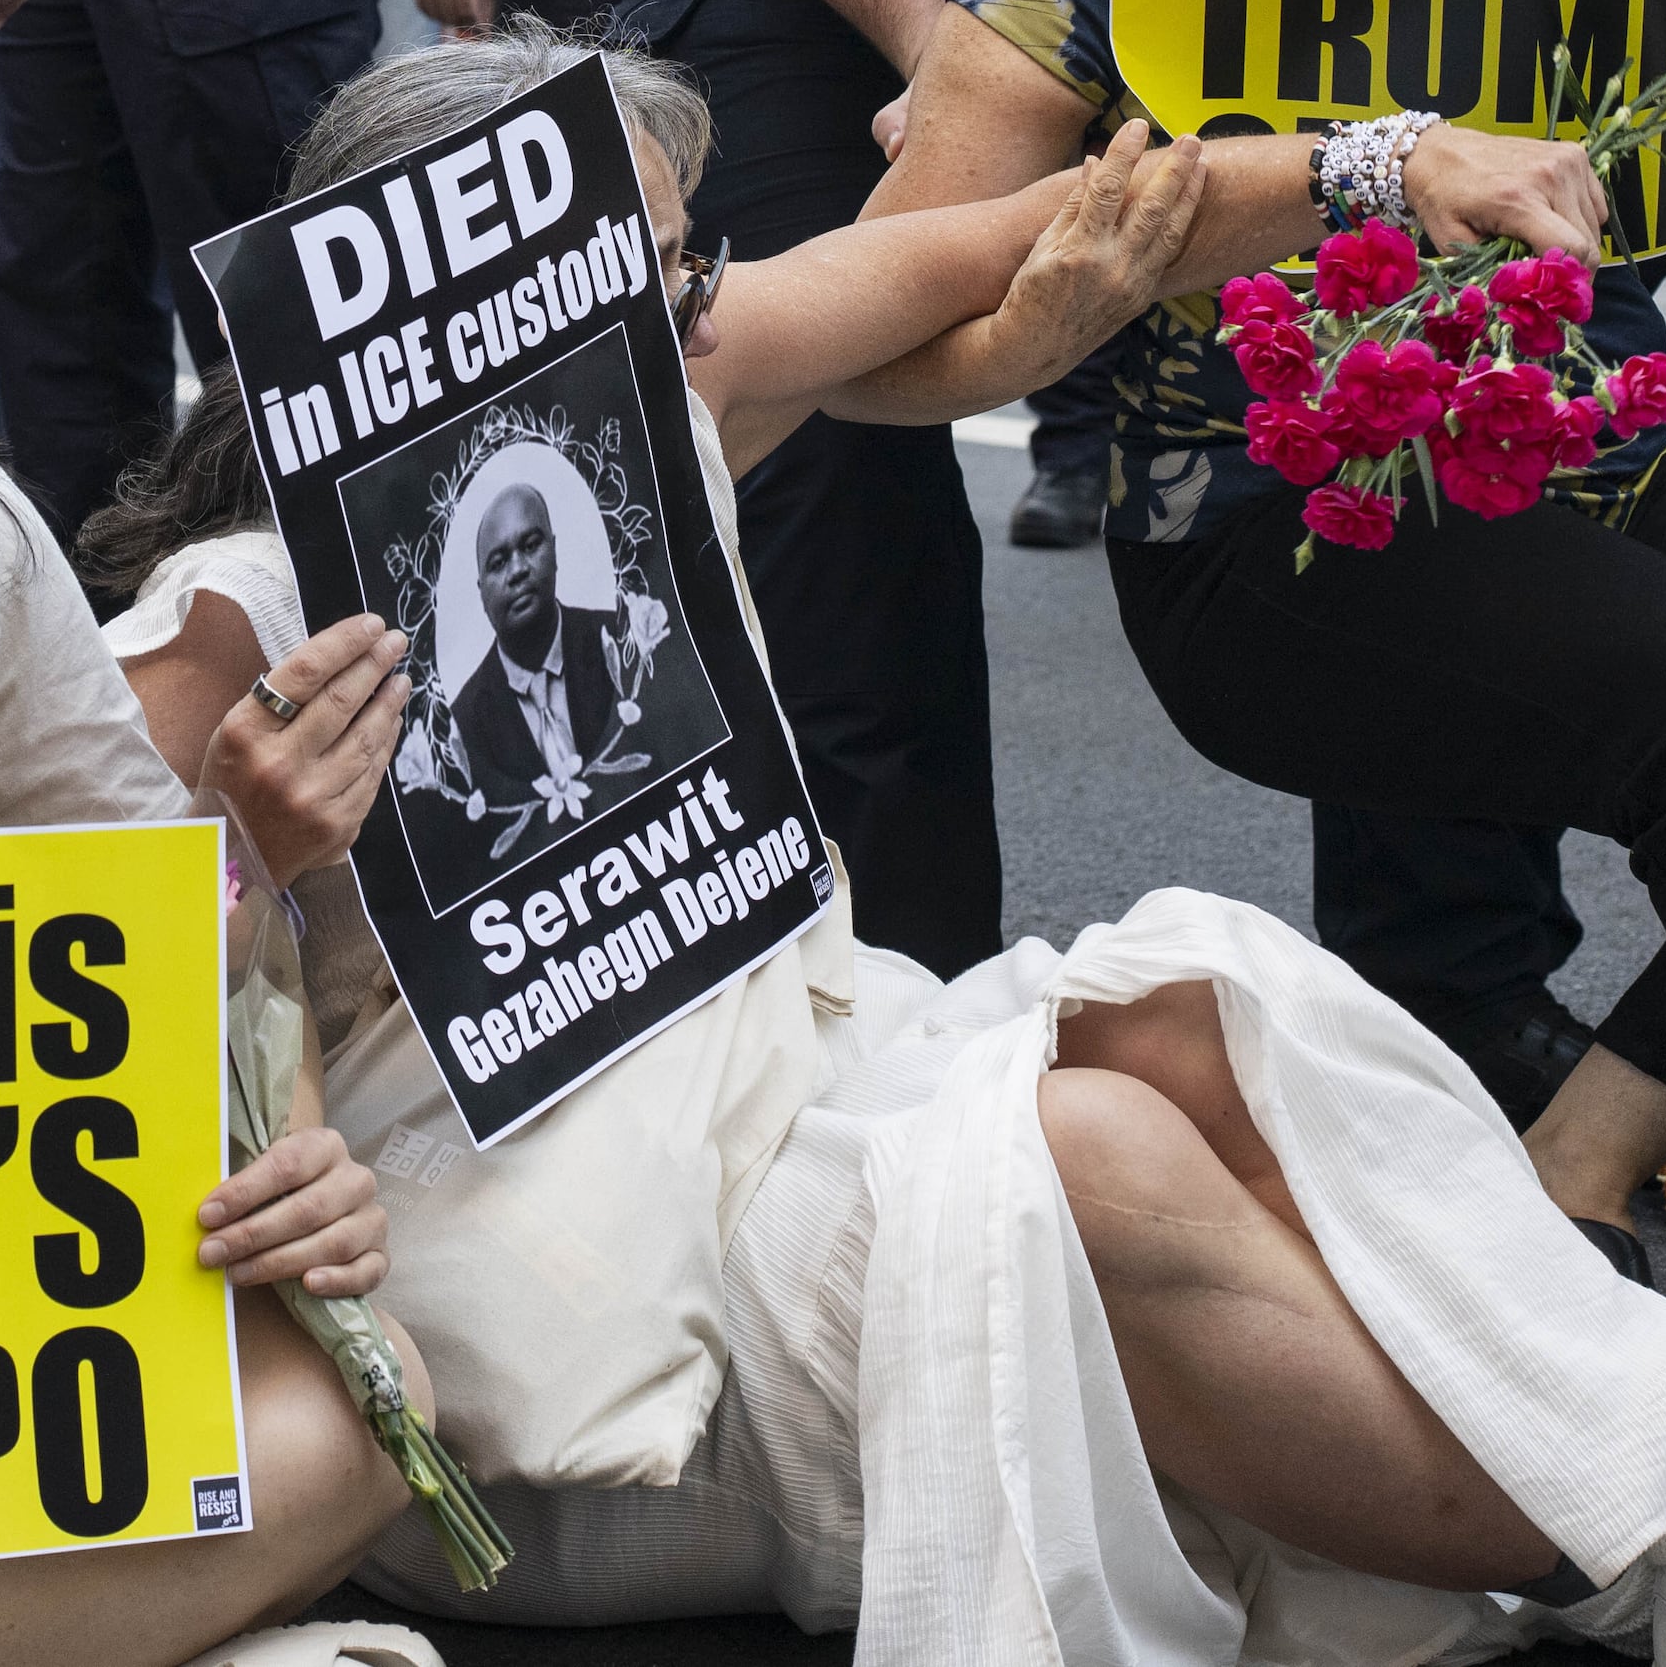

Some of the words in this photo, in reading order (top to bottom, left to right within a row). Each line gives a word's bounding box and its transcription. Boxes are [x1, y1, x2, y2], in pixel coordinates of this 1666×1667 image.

[290, 109, 574, 342] DIED
[259, 384, 341, 477] in
[338, 315, 444, 440] ICE
[445, 213, 648, 384] custody
[447, 908, 675, 1084] Gezahegn
[659, 816, 811, 947] Dejene
[469, 765, 745, 975] Serawit
[198, 1490, 218, 1503] RISE
[219, 1488, 237, 1502] AND
[199, 1499, 238, 1517] RESIST
[221, 1513, 240, 1528] .org
